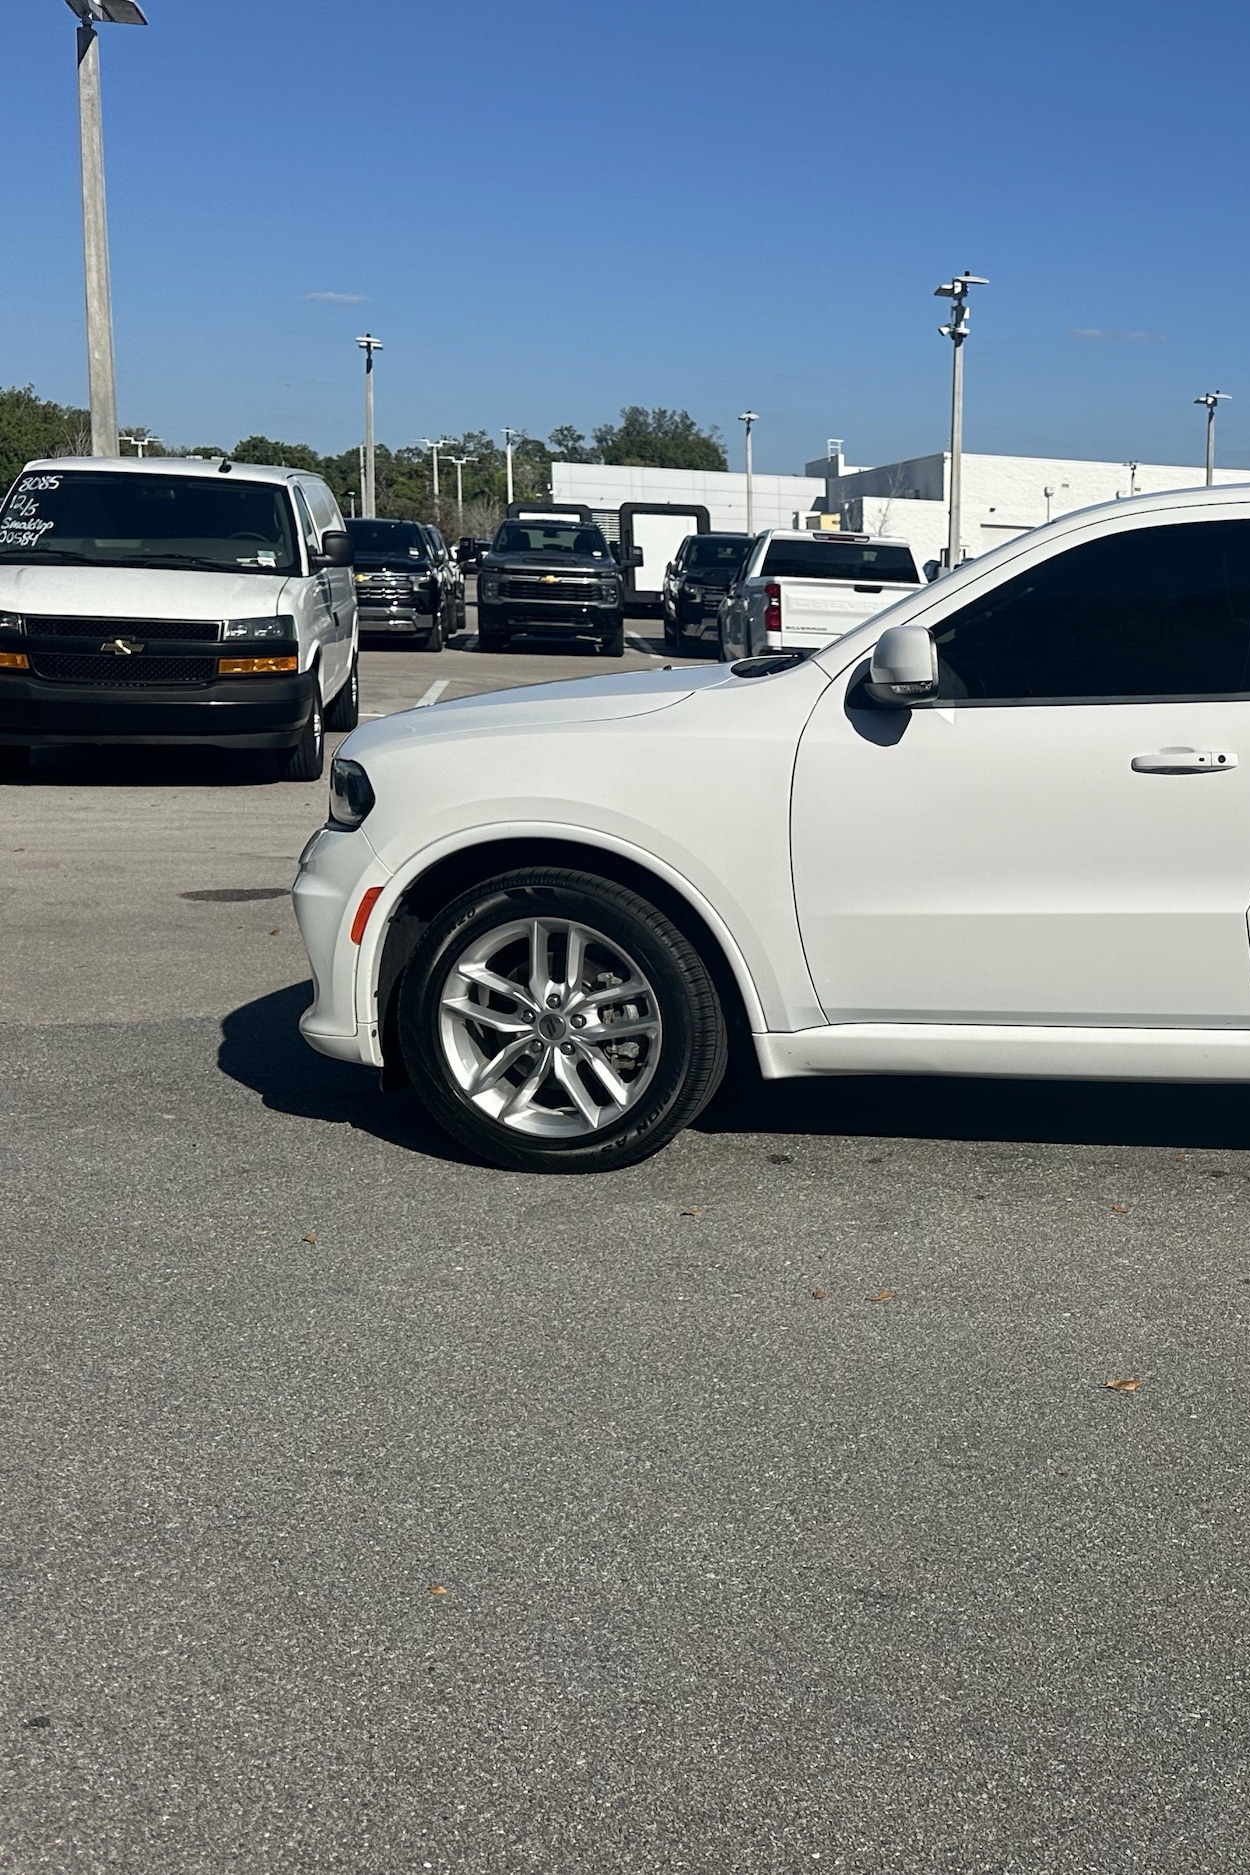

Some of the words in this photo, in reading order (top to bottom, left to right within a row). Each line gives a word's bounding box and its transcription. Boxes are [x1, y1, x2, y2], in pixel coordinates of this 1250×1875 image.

[18, 475, 64, 493] 8085
[9, 494, 40, 516] 12/5
[0, 530, 40, 547] 00584
